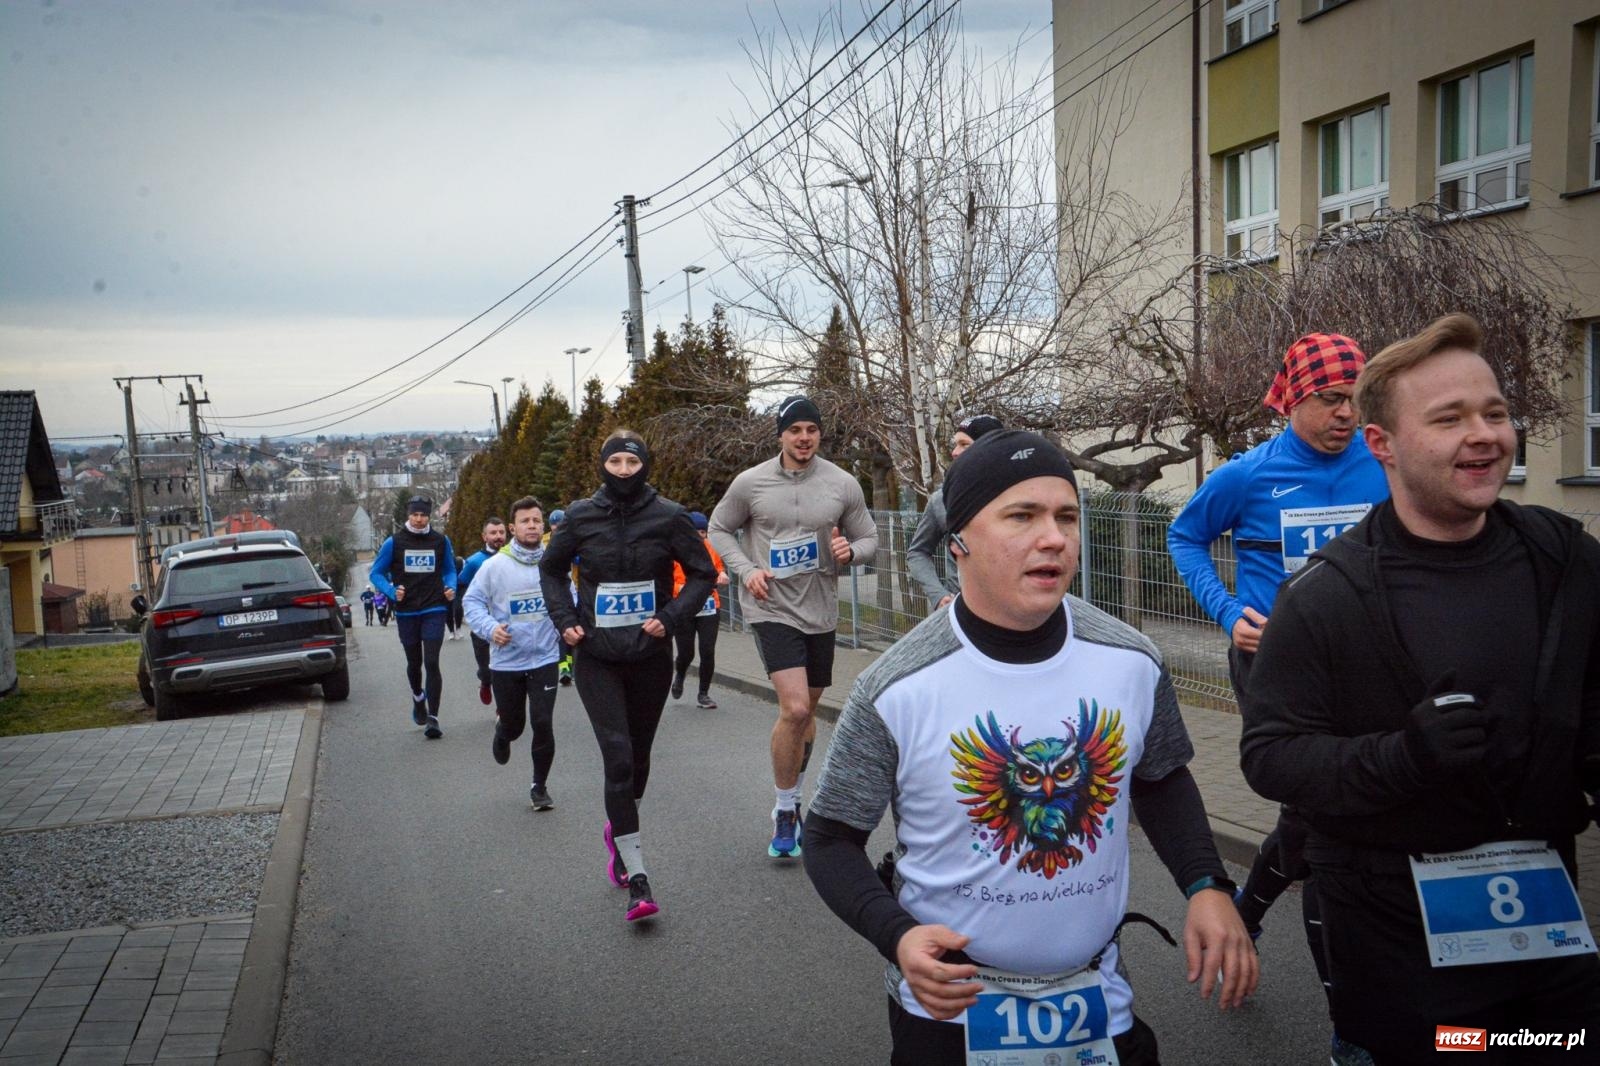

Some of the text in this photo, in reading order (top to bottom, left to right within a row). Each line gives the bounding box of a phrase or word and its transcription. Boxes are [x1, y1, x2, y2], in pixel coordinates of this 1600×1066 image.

[1301, 524, 1355, 555] 11
[410, 556, 430, 566] 164
[776, 545, 810, 567] 182
[517, 597, 547, 613] 232
[605, 594, 645, 614] 211
[226, 615, 239, 625] OP
[1450, 853, 1474, 862] Cross
[981, 886, 1015, 905] Bieg
[1486, 875, 1525, 924] 8
[1021, 977, 1032, 985] po
[994, 993, 1091, 1045] 102
